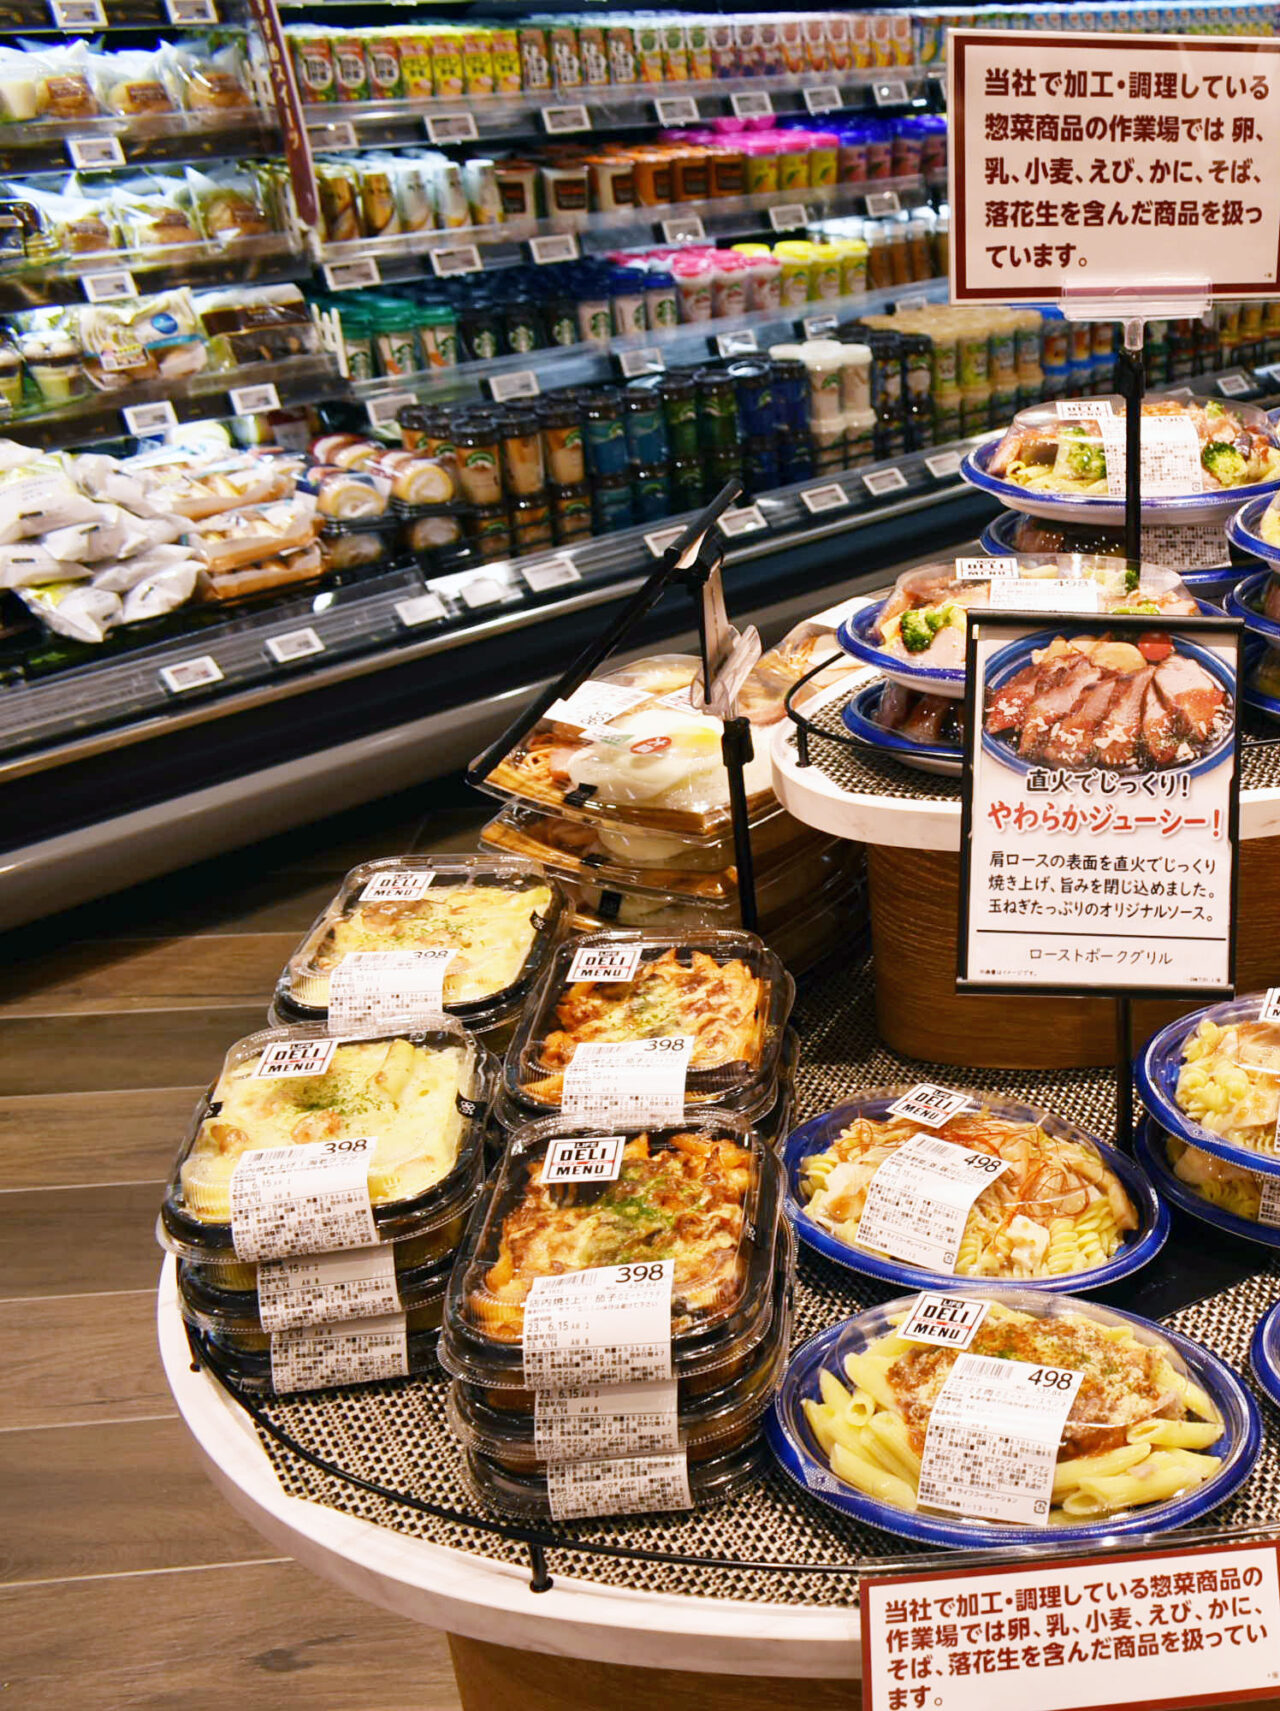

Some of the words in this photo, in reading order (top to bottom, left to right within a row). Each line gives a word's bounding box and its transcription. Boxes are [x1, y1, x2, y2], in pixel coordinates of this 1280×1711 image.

[985, 68, 1269, 100] 当社で加工・調理している
[985, 157, 1262, 184] 乳、小麦、えび、かに、そば、
[985, 200, 1262, 227] 落花生を含んだ商品を扱っ
[986, 243, 1087, 268] ています。
[1026, 769, 1190, 798] 直火でじっくり!
[988, 800, 1221, 838] やわらかジューシー!
[989, 851, 1216, 875] 肩ロースの表面を直火でじっくり
[373, 889, 413, 897] MENU
[379, 878, 420, 888] DELI
[988, 874, 1215, 899] 焼き上げ、旨みを閉じ込めました。
[988, 899, 1213, 922] 玉ねぎたっぷりのオリジナルソース。
[585, 956, 626, 966] DELI
[1029, 948, 1173, 966] ローストポークグリル
[580, 969, 623, 977] MENU
[273, 1048, 320, 1061] DELI
[643, 1038, 685, 1052] 398
[267, 1061, 316, 1074] MENU
[914, 1091, 954, 1110] DELI
[902, 1103, 941, 1121] MENU
[323, 1138, 368, 1156] 398
[560, 1149, 607, 1161] DELI
[556, 1165, 605, 1177] MENU
[963, 1153, 1003, 1174] 498
[615, 1263, 665, 1284] 398
[922, 1304, 970, 1325] DELI
[913, 1322, 961, 1341] MENU
[1028, 1368, 1074, 1391] 498
[884, 1565, 1263, 1626] 当社で加工・調理している惣菜商品の
[886, 1595, 1265, 1653] 作業場では卵、乳、小麦、えび、かに、
[887, 1622, 1268, 1681] そば、落花生を含んだ商品を扱ってい
[888, 1685, 943, 1710] ます。
